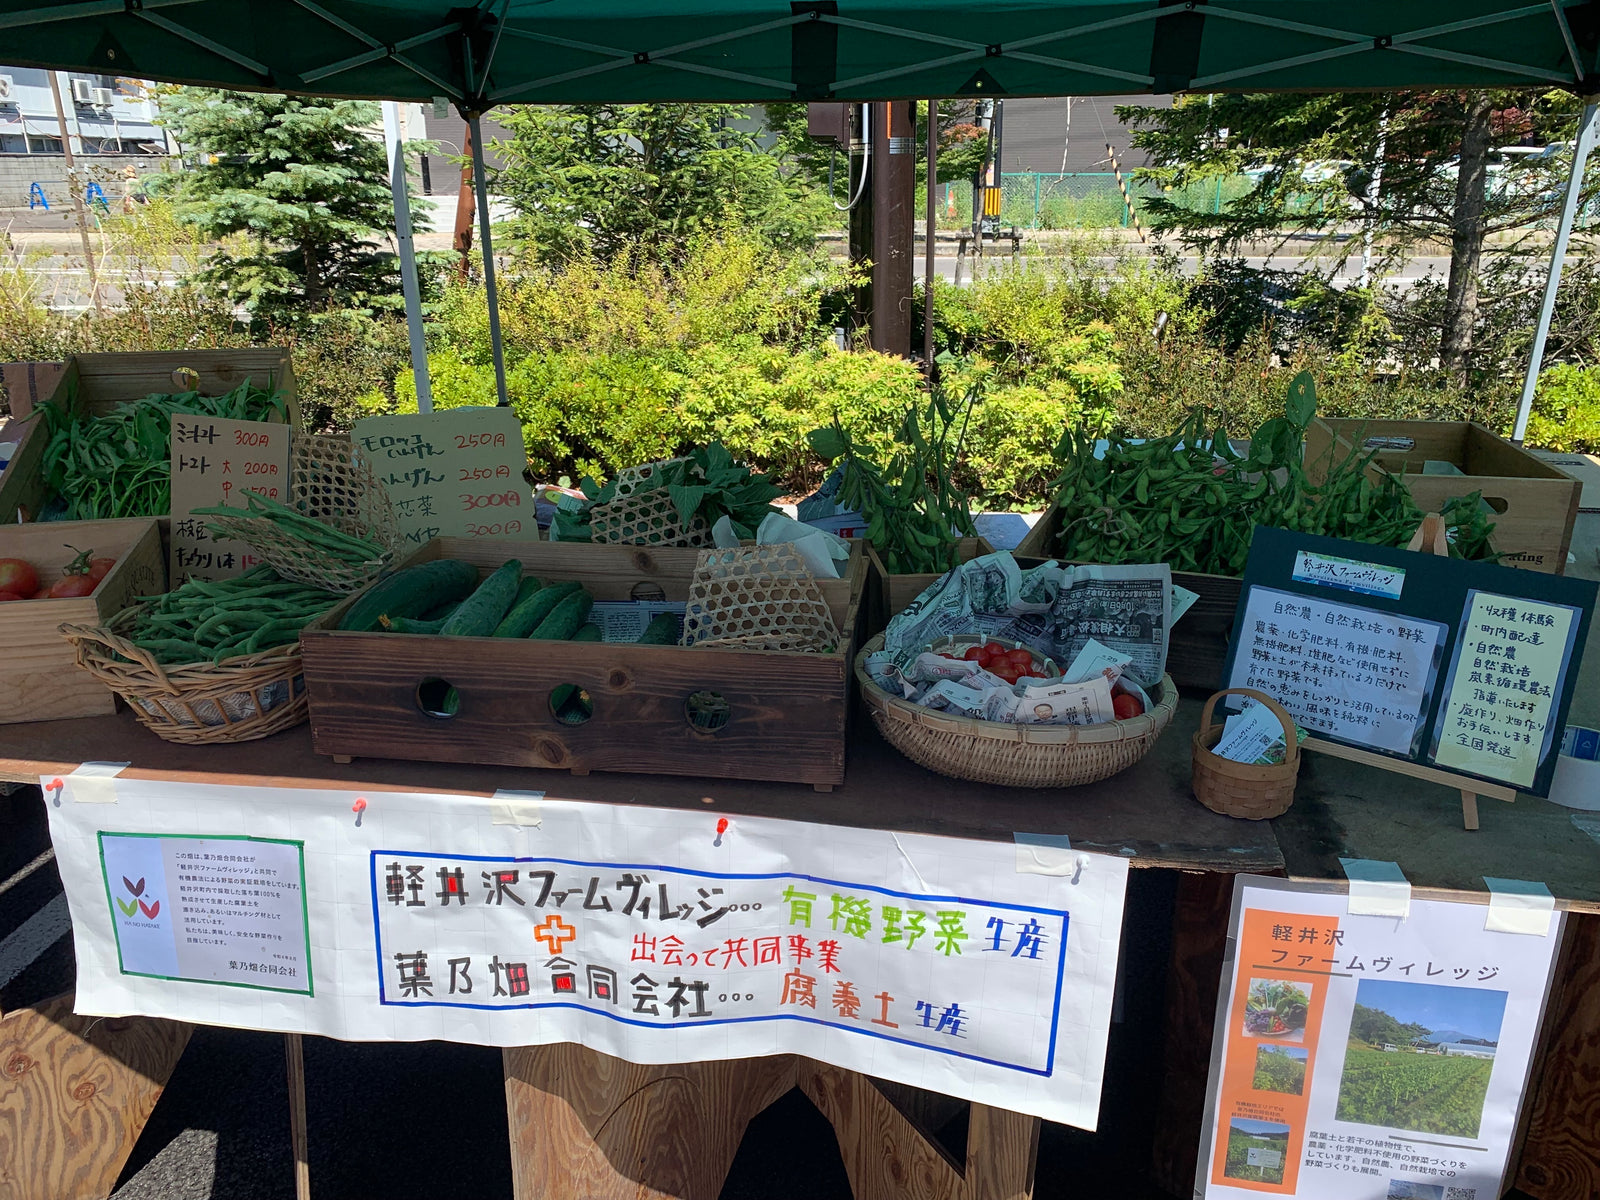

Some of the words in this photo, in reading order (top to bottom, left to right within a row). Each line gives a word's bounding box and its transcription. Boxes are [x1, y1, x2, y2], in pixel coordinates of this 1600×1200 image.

[234, 430, 269, 447] 300円
[360, 435, 423, 451] モロッコ
[454, 433, 505, 448] 250円
[179, 454, 211, 475] トマト
[222, 459, 232, 474] 大
[244, 462, 278, 475] 200円
[459, 465, 510, 482] 250円
[222, 481, 232, 499] 中
[246, 486, 278, 499] 50円
[458, 490, 521, 511] 300円
[176, 519, 208, 541] 枝豆
[465, 520, 521, 537] 300円
[1473, 657, 1531, 677] 自然栽培
[1473, 688, 1537, 714] 指導いたします
[782, 885, 969, 956] 有機野菜
[983, 916, 1051, 960] 生産
[1271, 923, 1345, 947] 軽井沢
[630, 932, 842, 973] 出会って共同事業
[228, 961, 297, 977] 葉乃畑合同会社
[1271, 949, 1500, 981] ファームヴィレッジ
[914, 1000, 968, 1039] 生産
[1304, 1160, 1383, 1177] 野菜づくりも展開。
